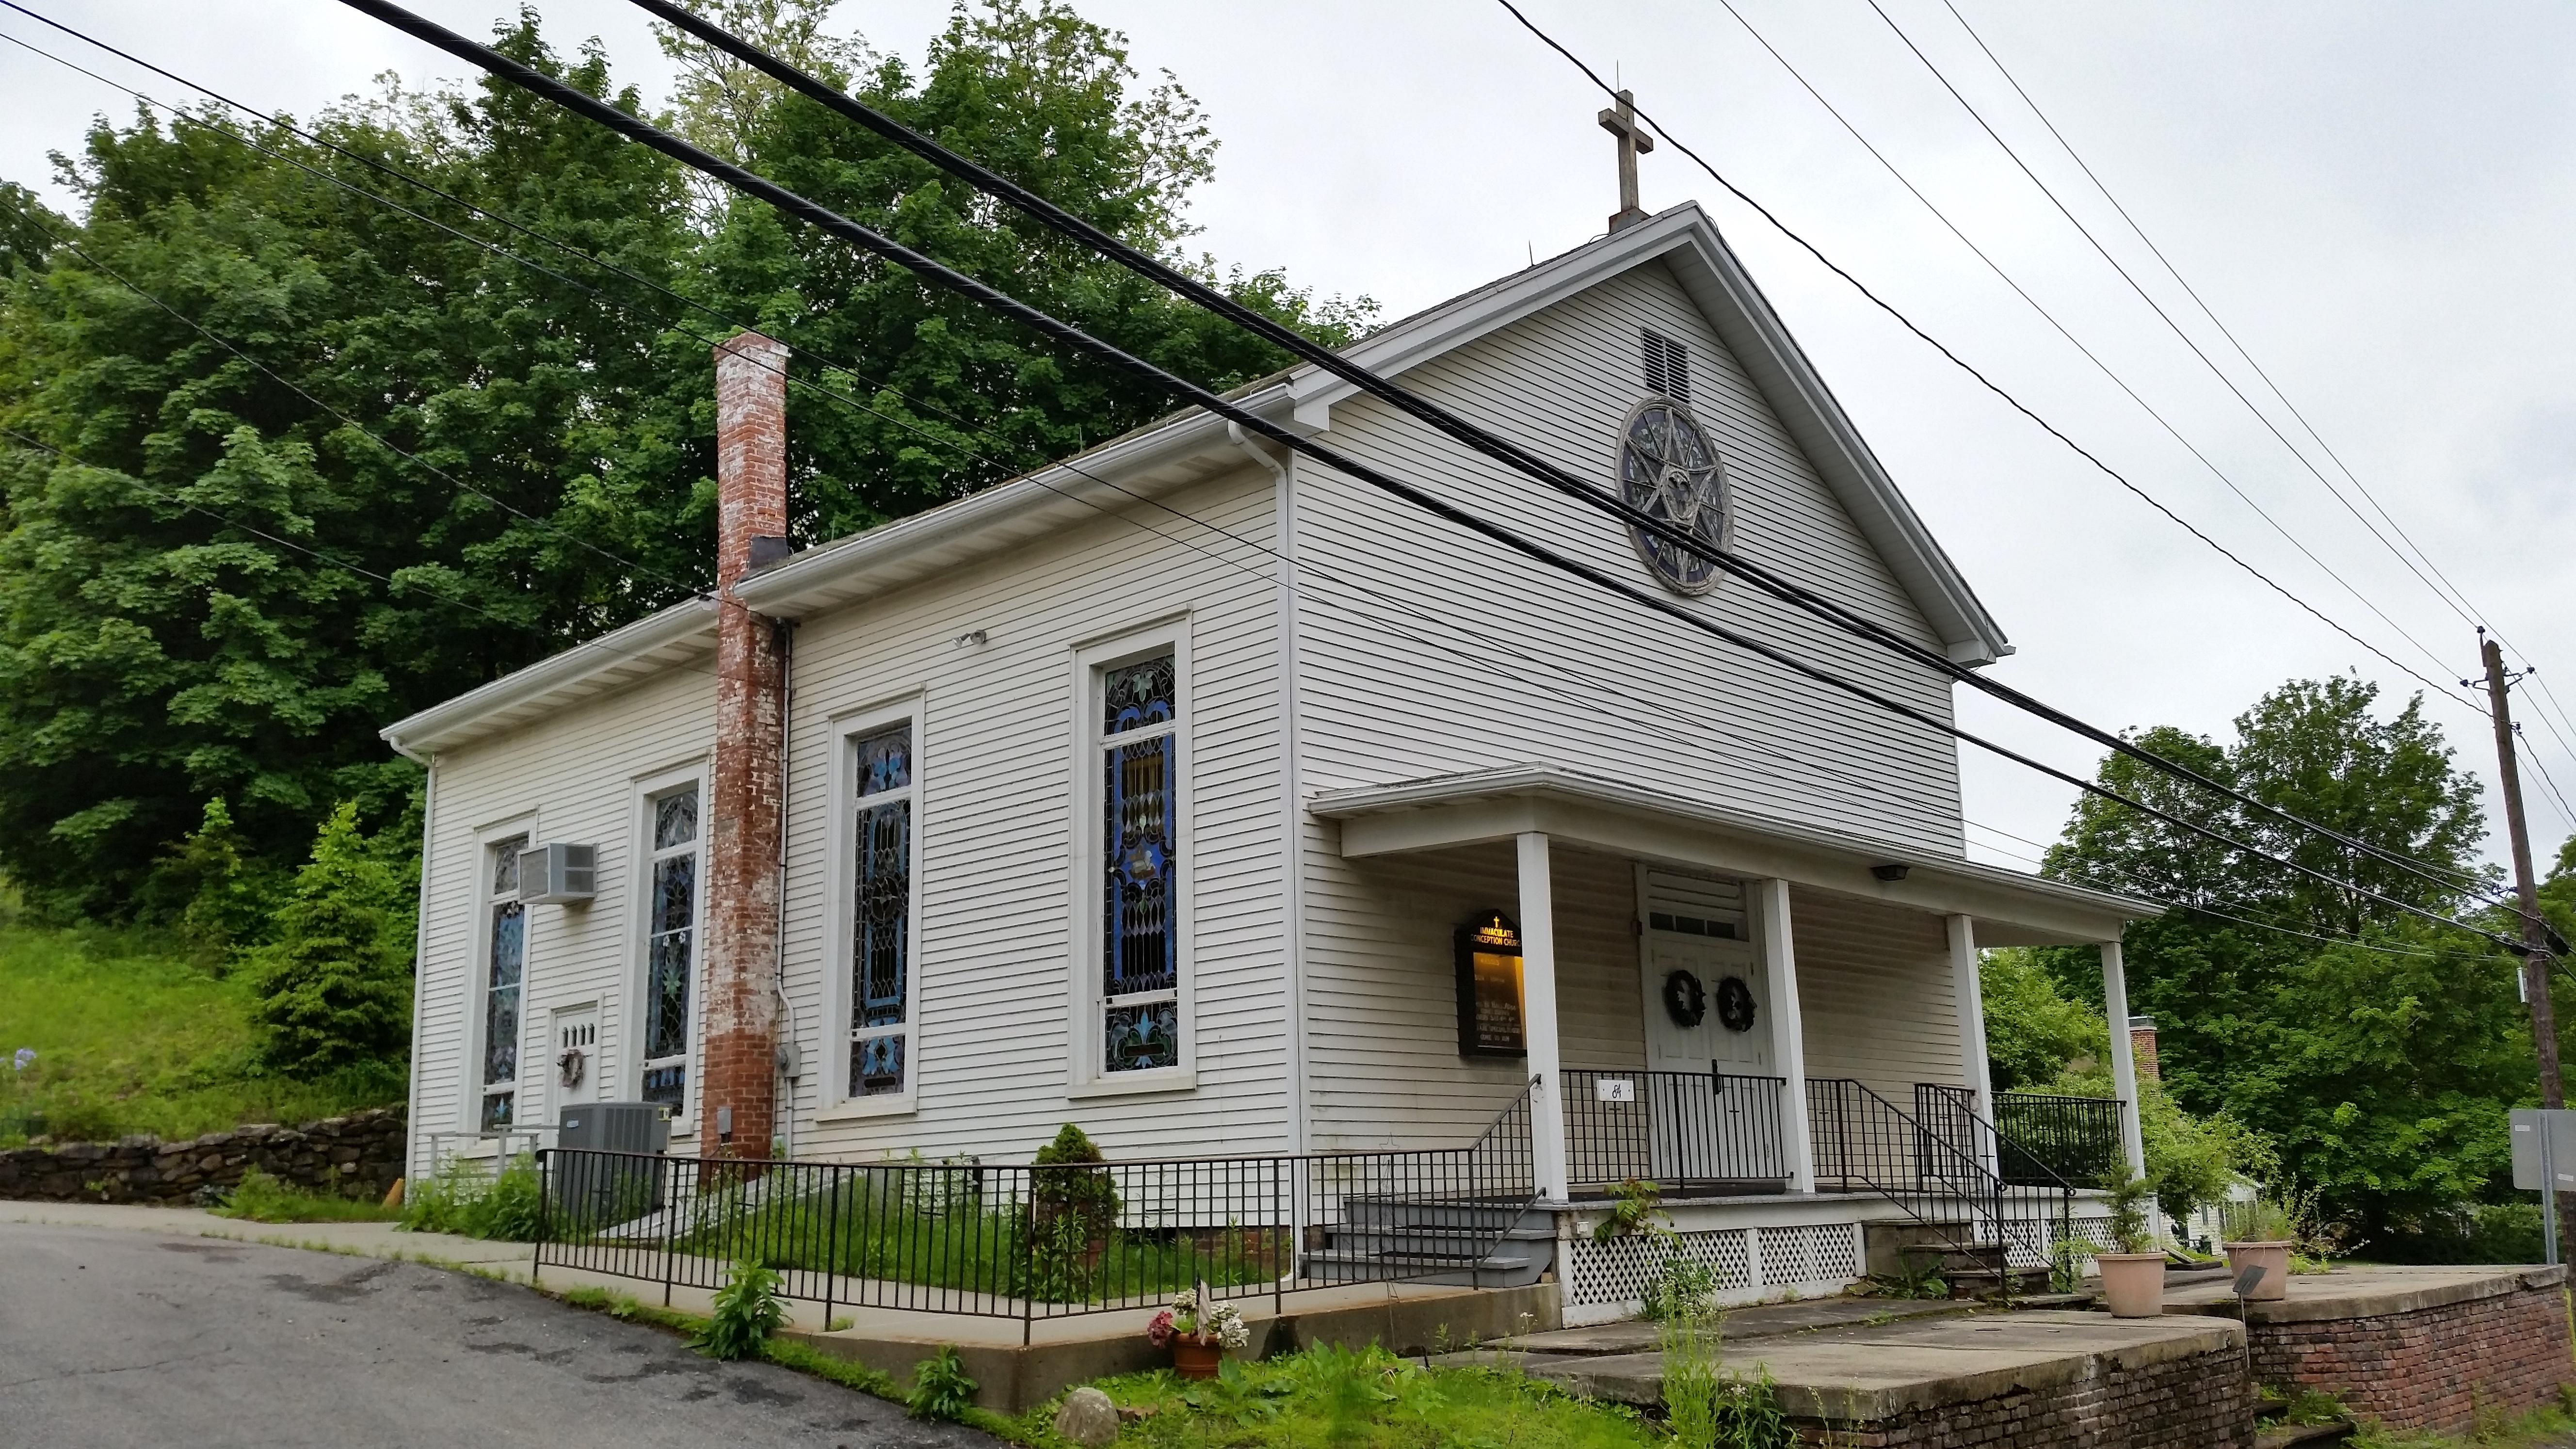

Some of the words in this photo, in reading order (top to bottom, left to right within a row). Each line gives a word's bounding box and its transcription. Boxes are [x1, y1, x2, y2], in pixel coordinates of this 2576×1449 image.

[1480, 927, 1513, 938] IMMACULATE
[1470, 934, 1502, 945] CONCEPTION
[1504, 938, 1521, 947] CHURC
